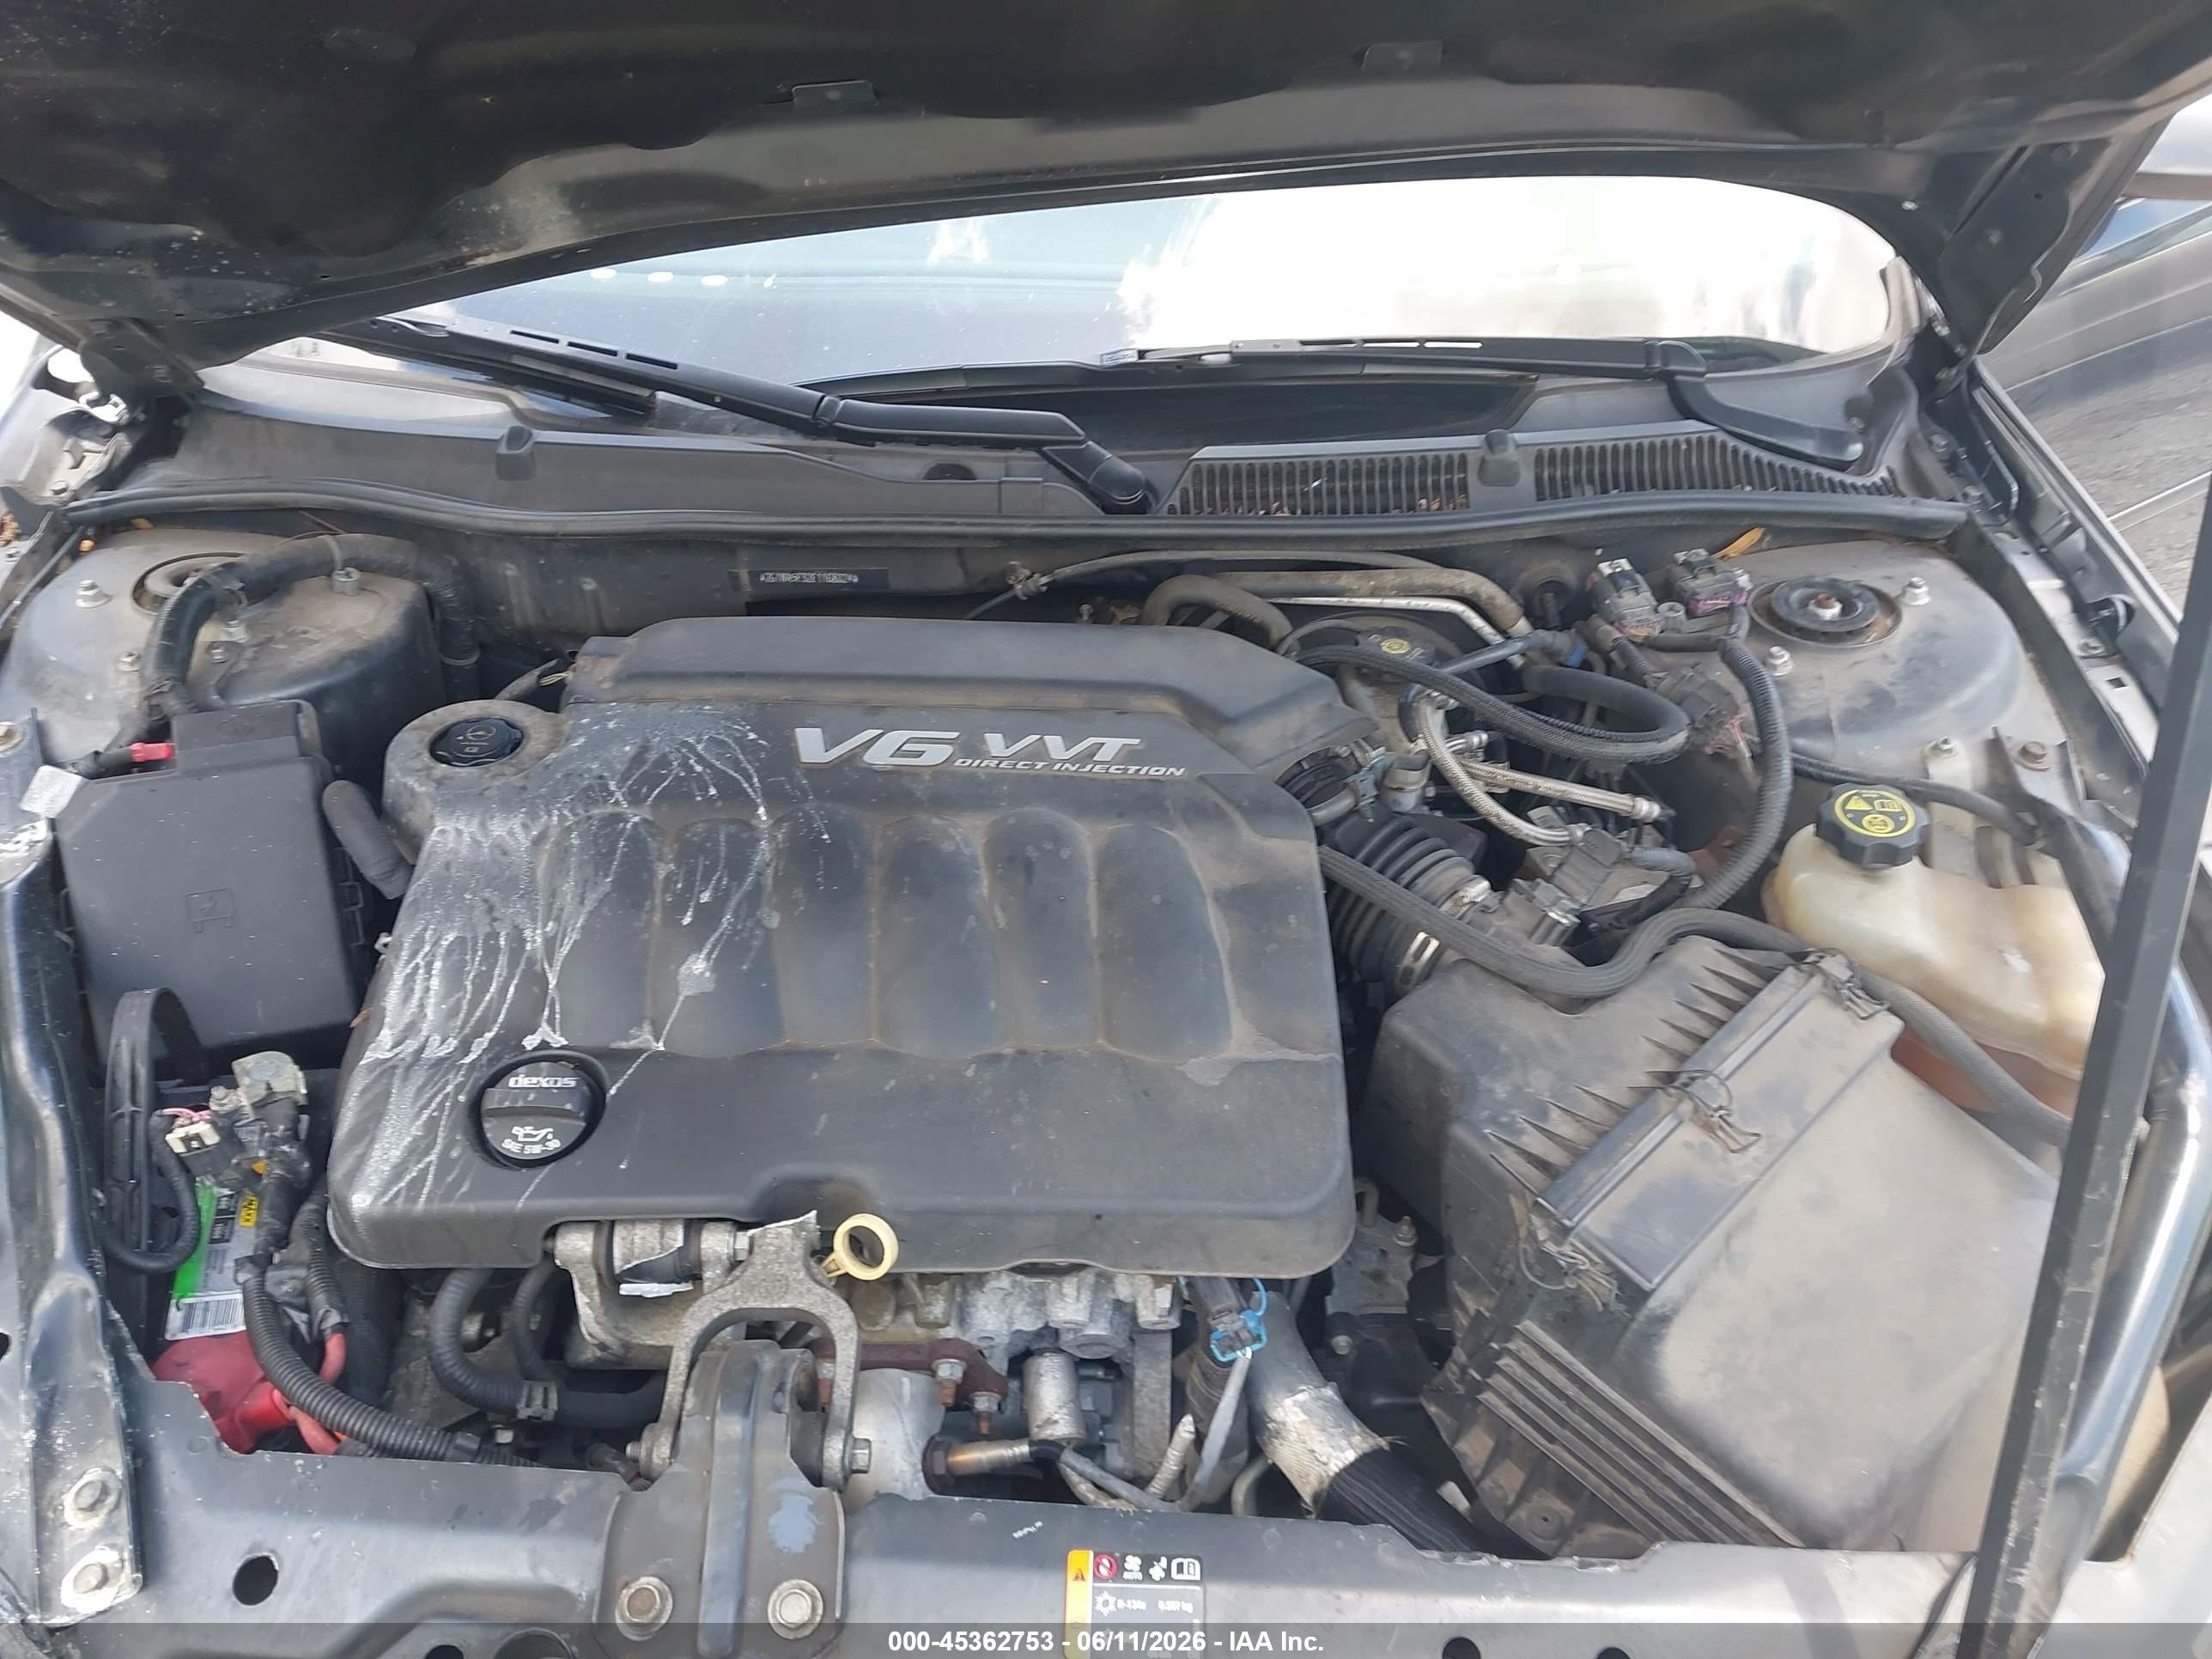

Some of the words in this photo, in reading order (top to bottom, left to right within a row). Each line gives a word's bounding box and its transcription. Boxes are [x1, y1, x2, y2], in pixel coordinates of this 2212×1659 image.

[795, 728, 961, 766] V6
[983, 733, 1141, 763] VVT
[953, 757, 1049, 770] DIRECT
[1052, 762, 1186, 777] INJECTION
[508, 1074, 580, 1088] dexos
